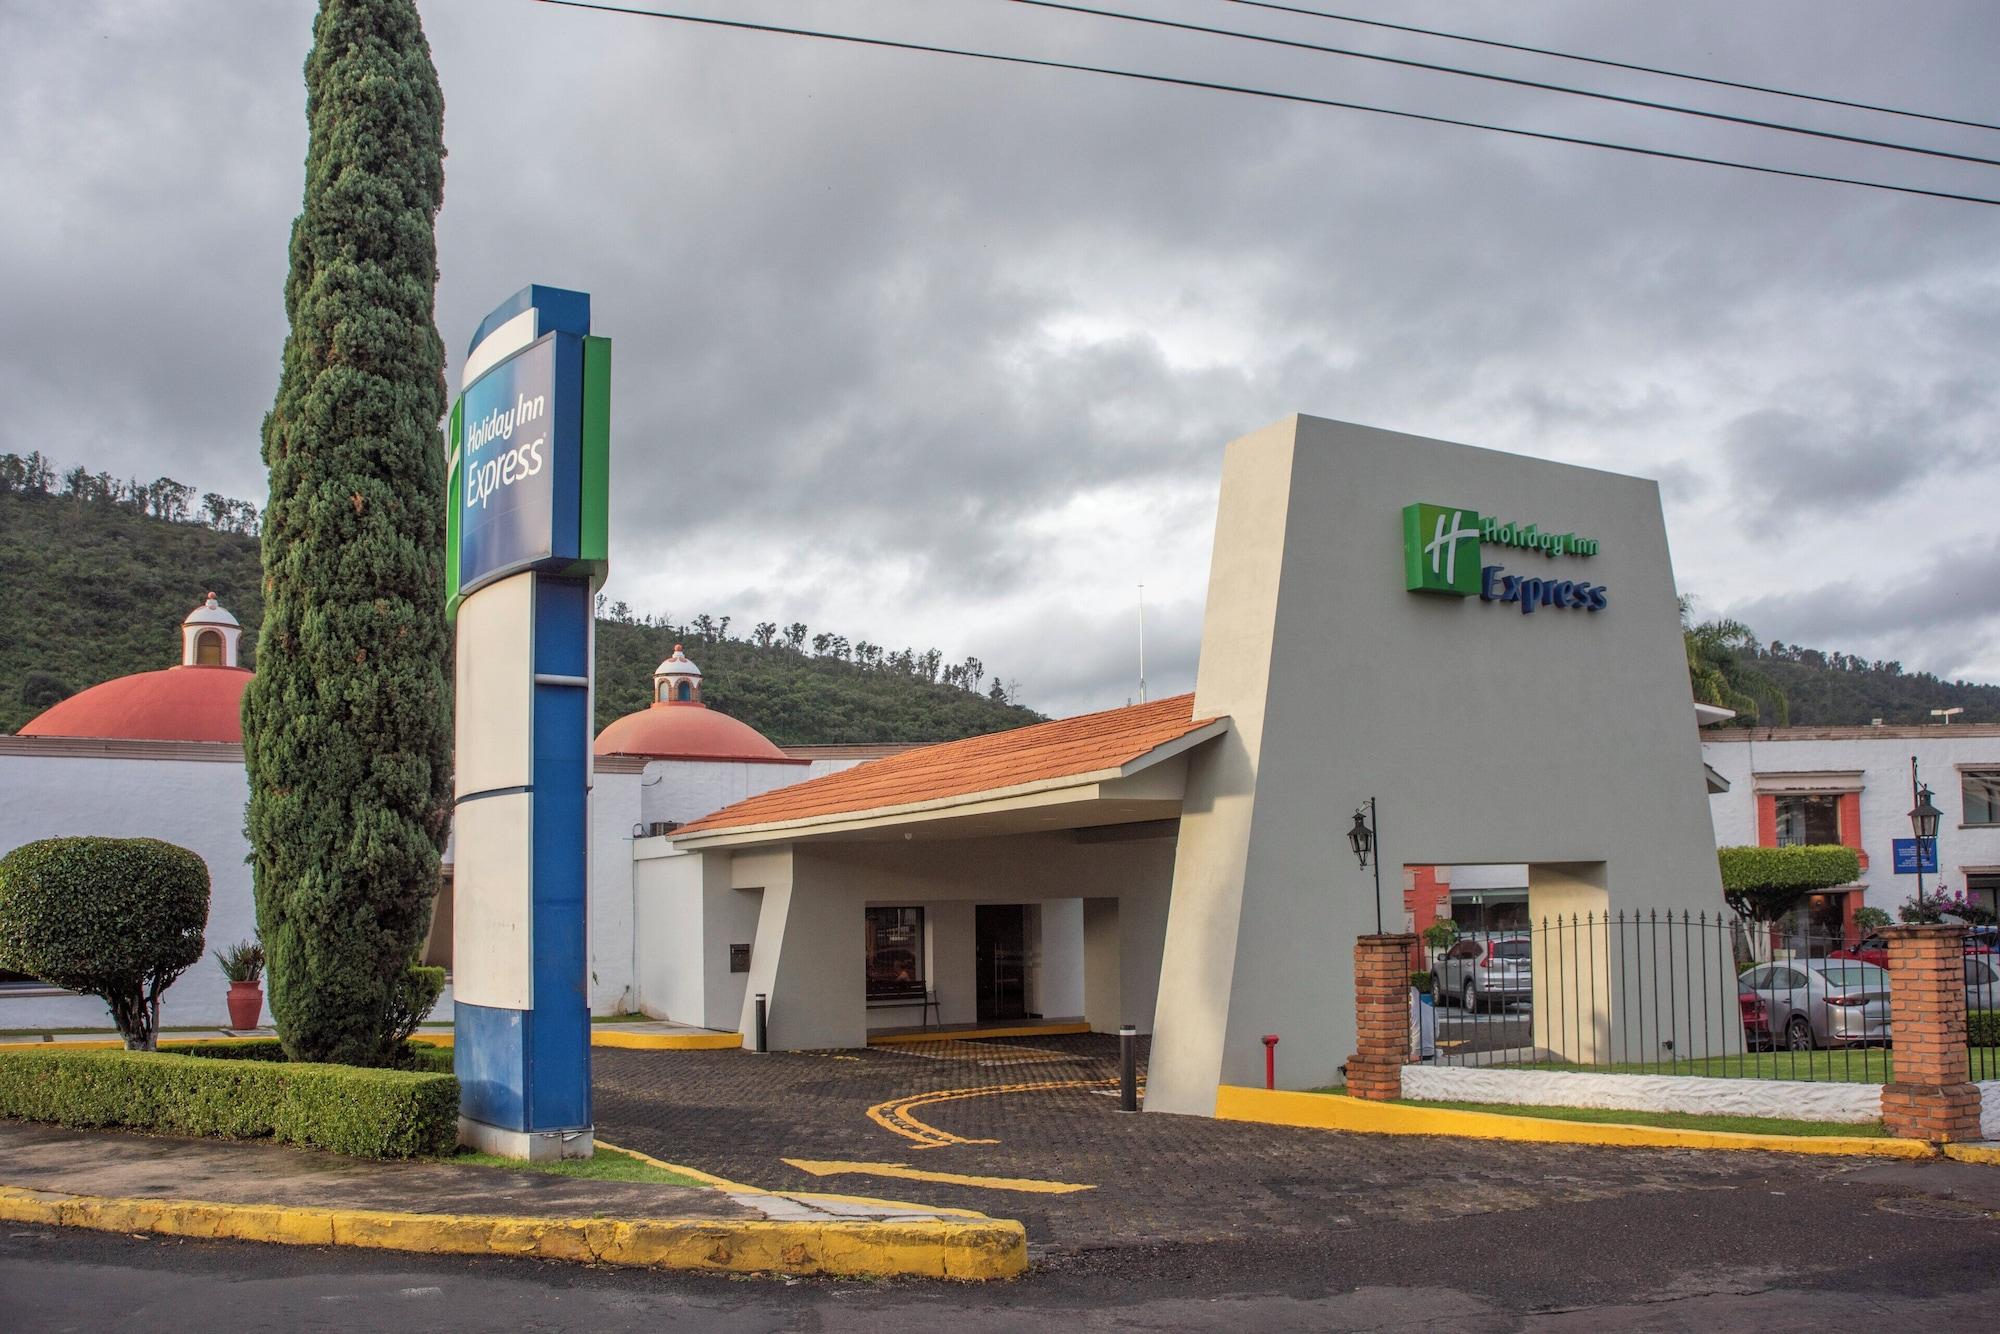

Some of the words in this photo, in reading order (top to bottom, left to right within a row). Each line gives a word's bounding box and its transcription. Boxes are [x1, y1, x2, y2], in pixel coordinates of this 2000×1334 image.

[467, 407, 515, 456] Holiday
[516, 393, 545, 427] Inn
[466, 437, 545, 509] Express
[1480, 517, 1564, 557] Holiday
[1564, 532, 1600, 556] Inn
[1480, 564, 1608, 614] Express
